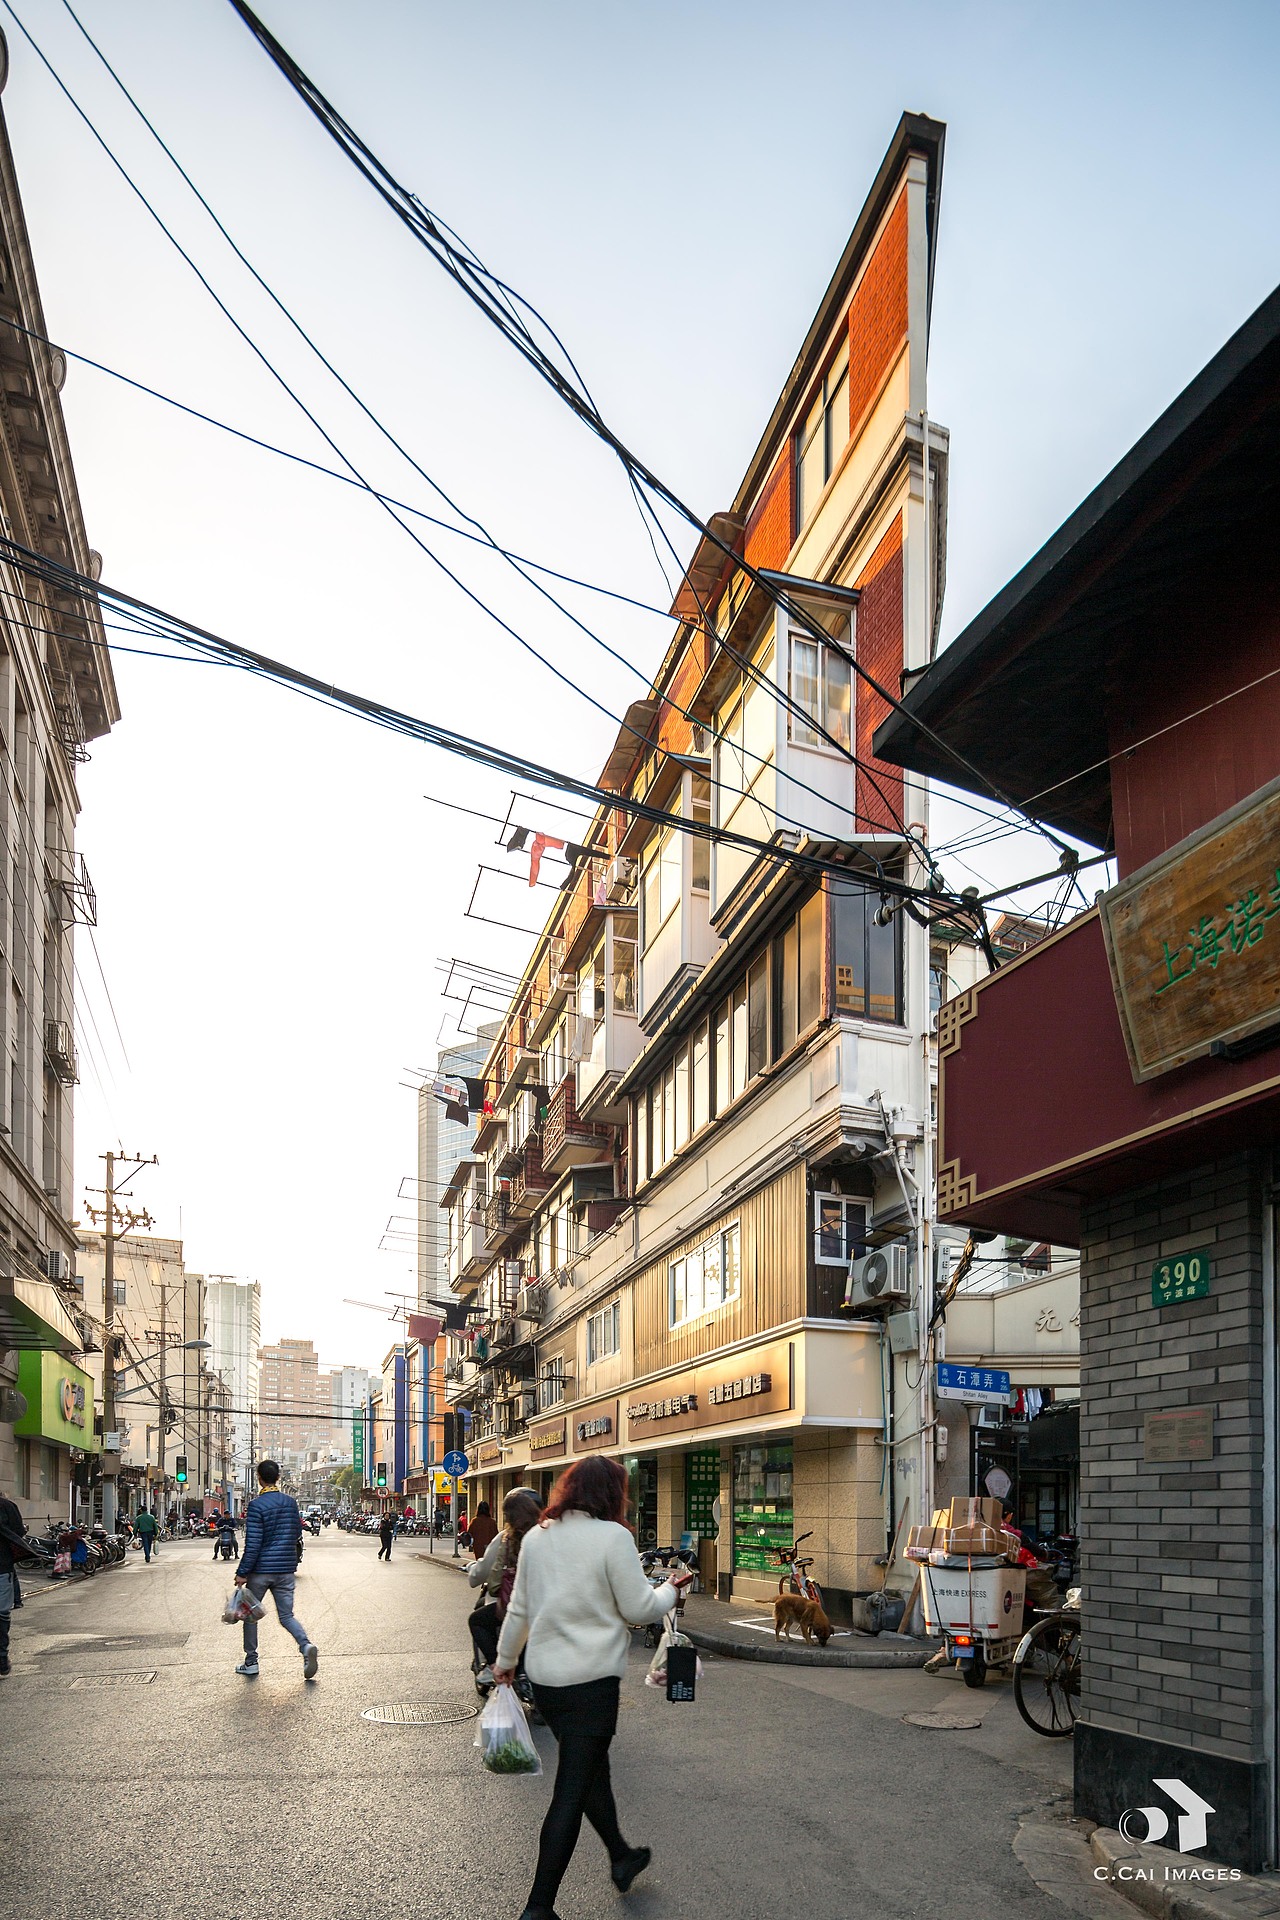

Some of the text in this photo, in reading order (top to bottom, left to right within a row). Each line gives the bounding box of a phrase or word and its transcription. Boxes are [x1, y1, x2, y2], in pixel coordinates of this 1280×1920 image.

[1159, 1257, 1201, 1289] 390
[1163, 1285, 1196, 1301] 宁波路
[956, 1370, 993, 1388] 石潭弄
[943, 1388, 948, 1396] S
[977, 1392, 989, 1400] Alley
